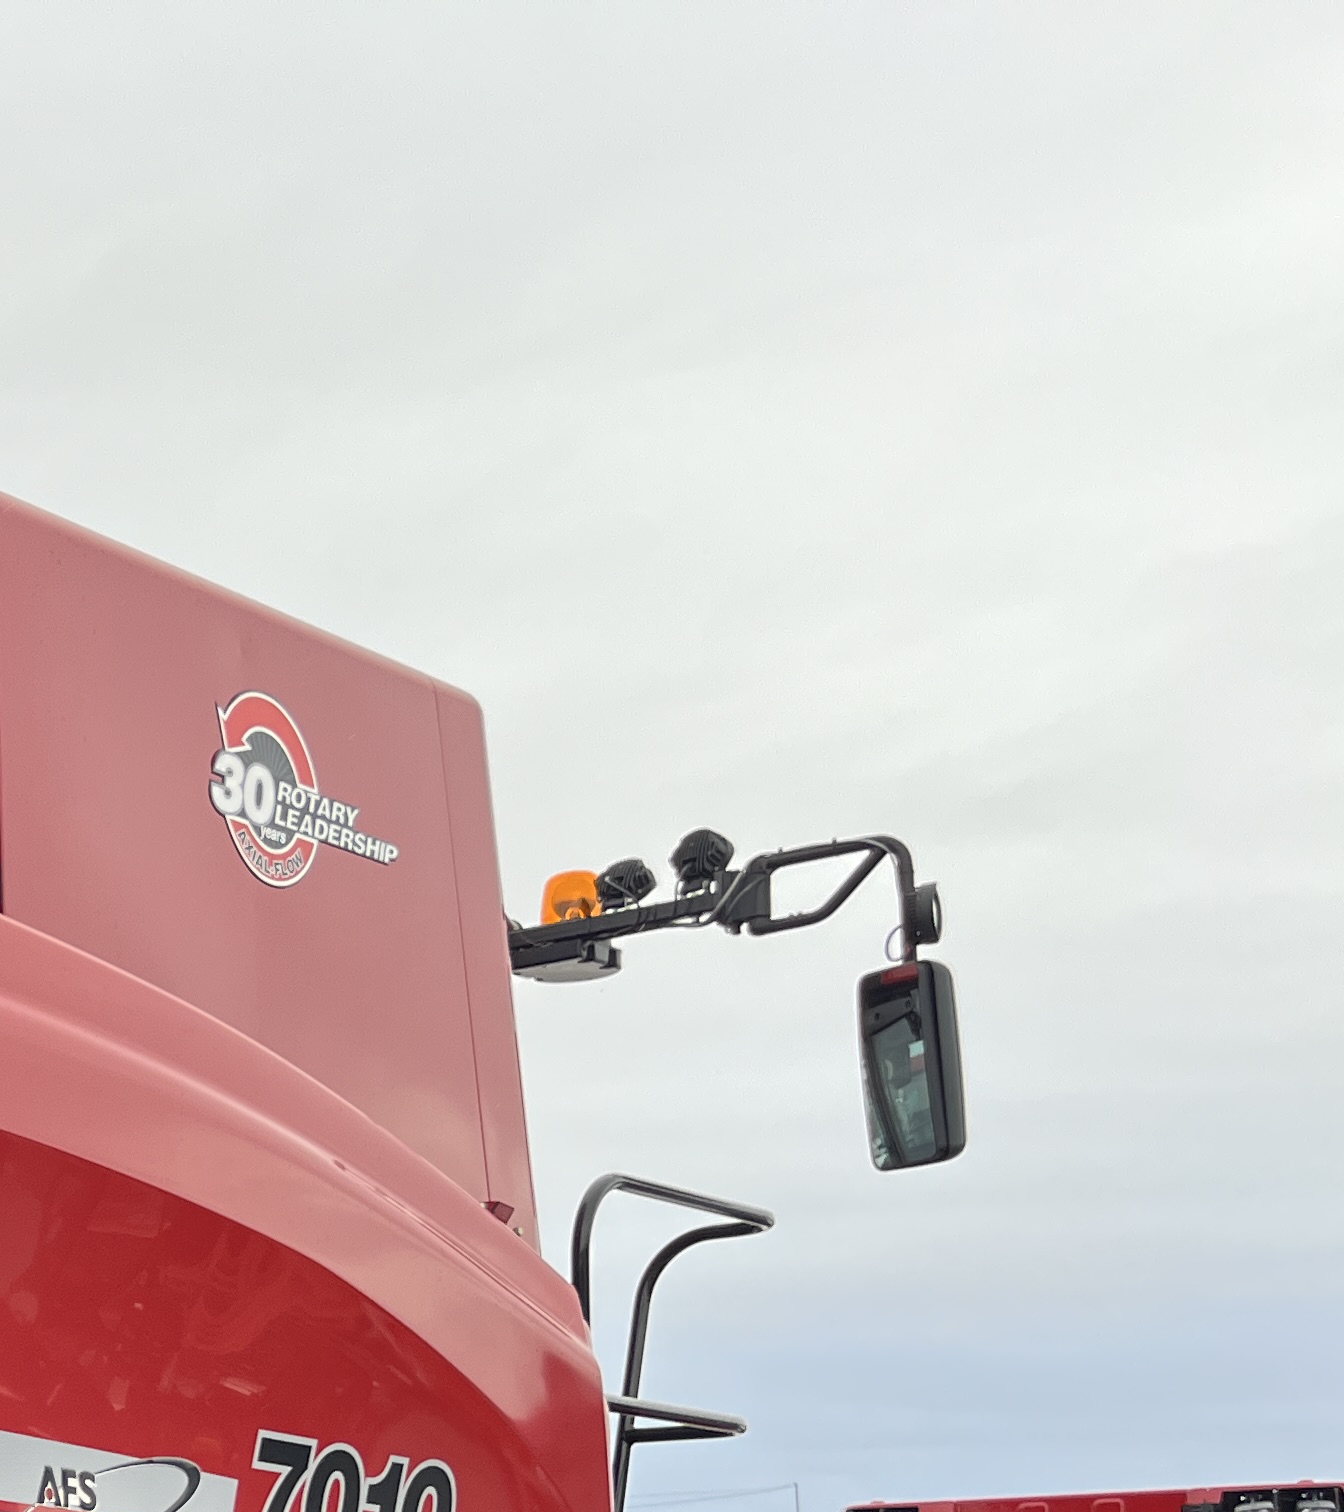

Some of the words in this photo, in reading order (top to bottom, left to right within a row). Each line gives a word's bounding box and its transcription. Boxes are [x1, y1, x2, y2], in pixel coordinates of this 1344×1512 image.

[210, 751, 275, 826] 30
[276, 780, 360, 828] ROTARY
[259, 825, 288, 845] years
[273, 804, 399, 865] LEADERSHIP
[37, 1465, 99, 1512] AFS
